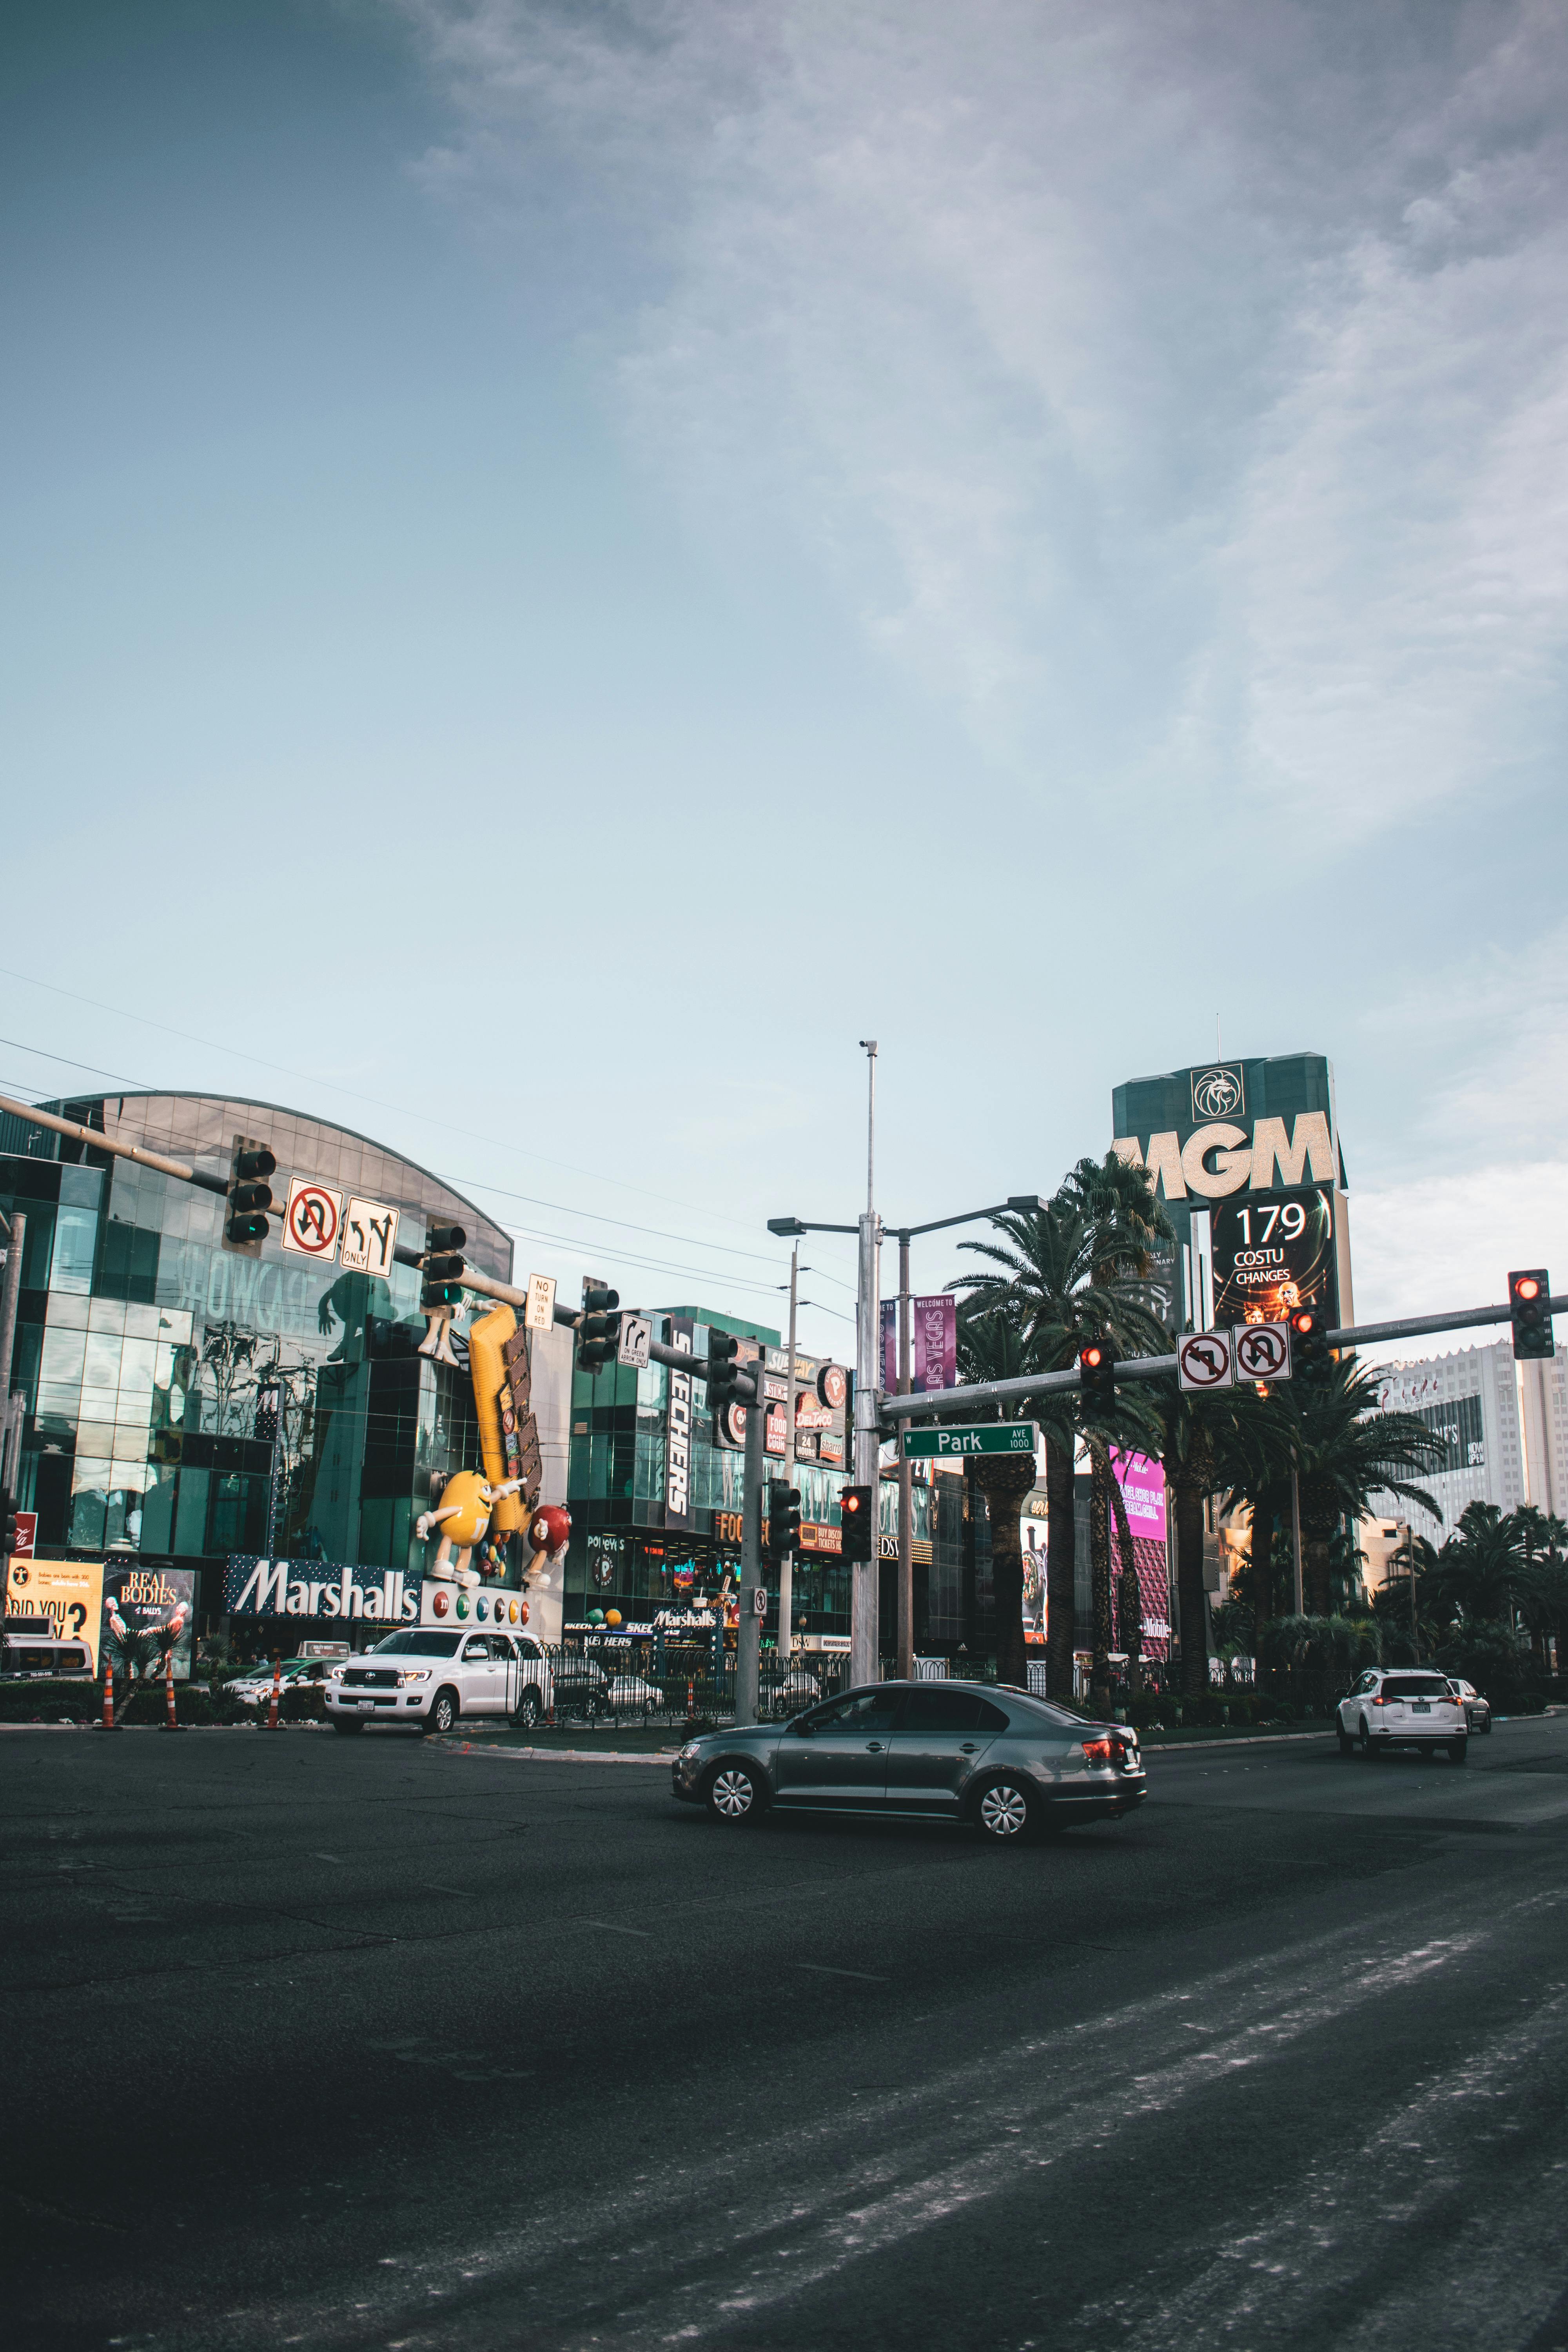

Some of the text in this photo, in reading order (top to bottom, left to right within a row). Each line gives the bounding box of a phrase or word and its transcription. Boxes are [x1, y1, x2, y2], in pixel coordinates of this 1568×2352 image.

[1112, 1111, 1336, 1200] MGM
[1237, 1203, 1306, 1244] 179
[345, 1251, 367, 1265] ONLY
[1234, 1248, 1284, 1267] COSTU
[1236, 1269, 1291, 1285] CHANGES
[536, 1280, 548, 1292] NO
[535, 1293, 548, 1303] TURN
[916, 1299, 944, 1308] WELCOME
[537, 1305, 544, 1314] ON
[534, 1316, 544, 1325] RED
[926, 1310, 944, 1391] LAS VEGAS
[826, 1367, 844, 1386] LOUISIANA
[768, 1383, 785, 1398] STICK
[831, 1376, 840, 1396] P
[827, 1391, 844, 1406] KITCHEN
[770, 1417, 787, 1434] FOOD
[906, 1436, 911, 1444] W
[1012, 1429, 1026, 1438] AVE
[768, 1433, 786, 1451] COUR
[802, 1436, 811, 1447] 24
[822, 1439, 841, 1454] sbarro
[938, 1431, 982, 1452] Park
[1010, 1439, 1029, 1448] 1000
[1467, 1441, 1483, 1454] NOW
[797, 1446, 815, 1457] HOURS
[1468, 1452, 1484, 1465] OPEN
[818, 1527, 828, 1537] BUY
[818, 1538, 835, 1550] TICKETS
[129, 1572, 170, 1589] REAL
[120, 1586, 176, 1605] BODIES
[234, 1560, 418, 1621] Marshalls
[12, 1599, 34, 1615] DID
[40, 1600, 66, 1622] YOU
[653, 1610, 717, 1627] Marshalls
[793, 1637, 810, 1648] DSW
